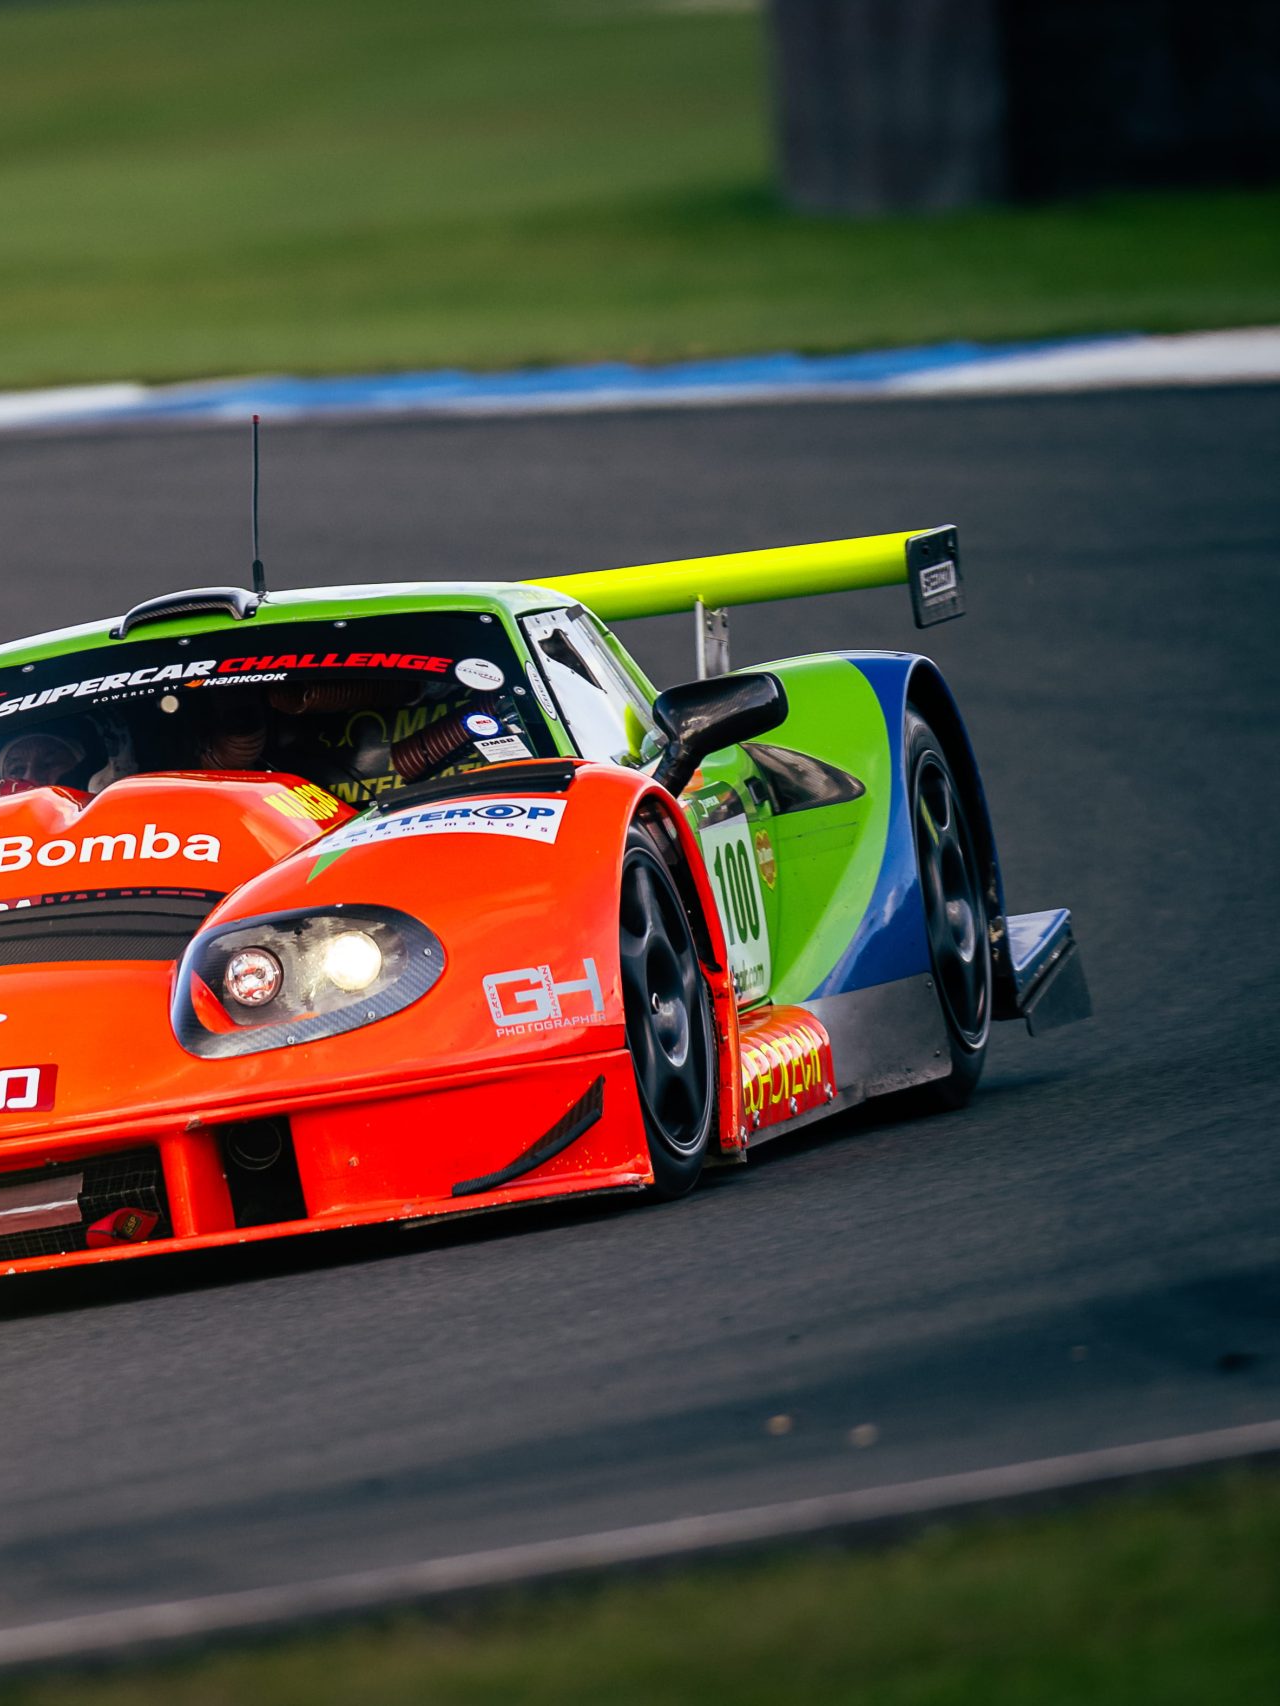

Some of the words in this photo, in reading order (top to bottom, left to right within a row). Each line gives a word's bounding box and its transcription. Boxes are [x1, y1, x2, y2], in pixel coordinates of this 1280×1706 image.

[216, 653, 454, 673] CHALLENGE
[93, 688, 155, 704] POWERED
[163, 684, 179, 693] BY
[481, 738, 514, 747] DMSB
[714, 839, 760, 945] 100
[482, 958, 605, 1026] GH
[496, 1013, 606, 1038] PHOTOGRAPHER
